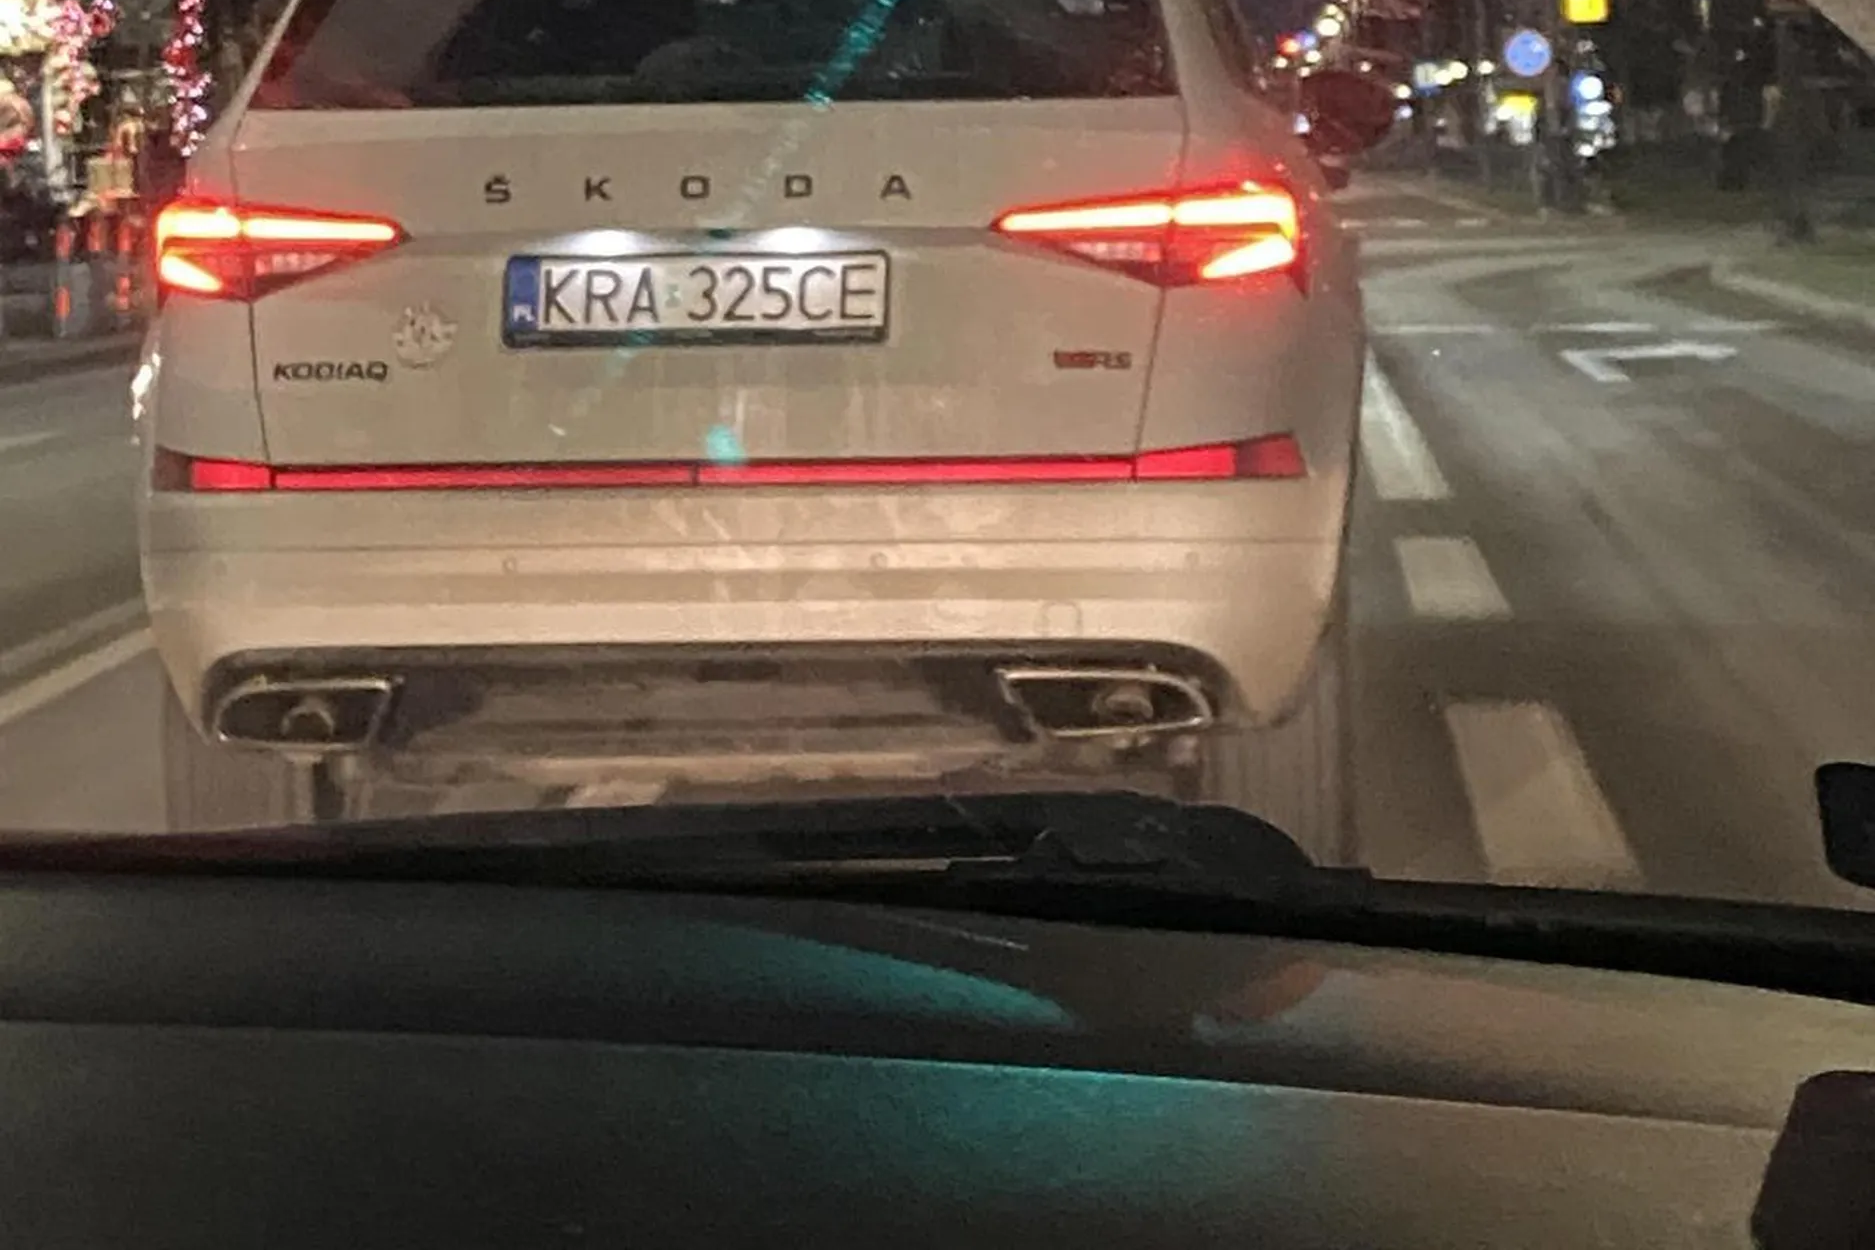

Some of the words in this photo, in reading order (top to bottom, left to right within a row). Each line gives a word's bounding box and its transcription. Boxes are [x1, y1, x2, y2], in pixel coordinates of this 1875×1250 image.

[543, 267, 660, 324] KRA
[687, 264, 877, 323] 325CE
[512, 304, 536, 323] PL
[273, 361, 389, 382] KODIAQ
